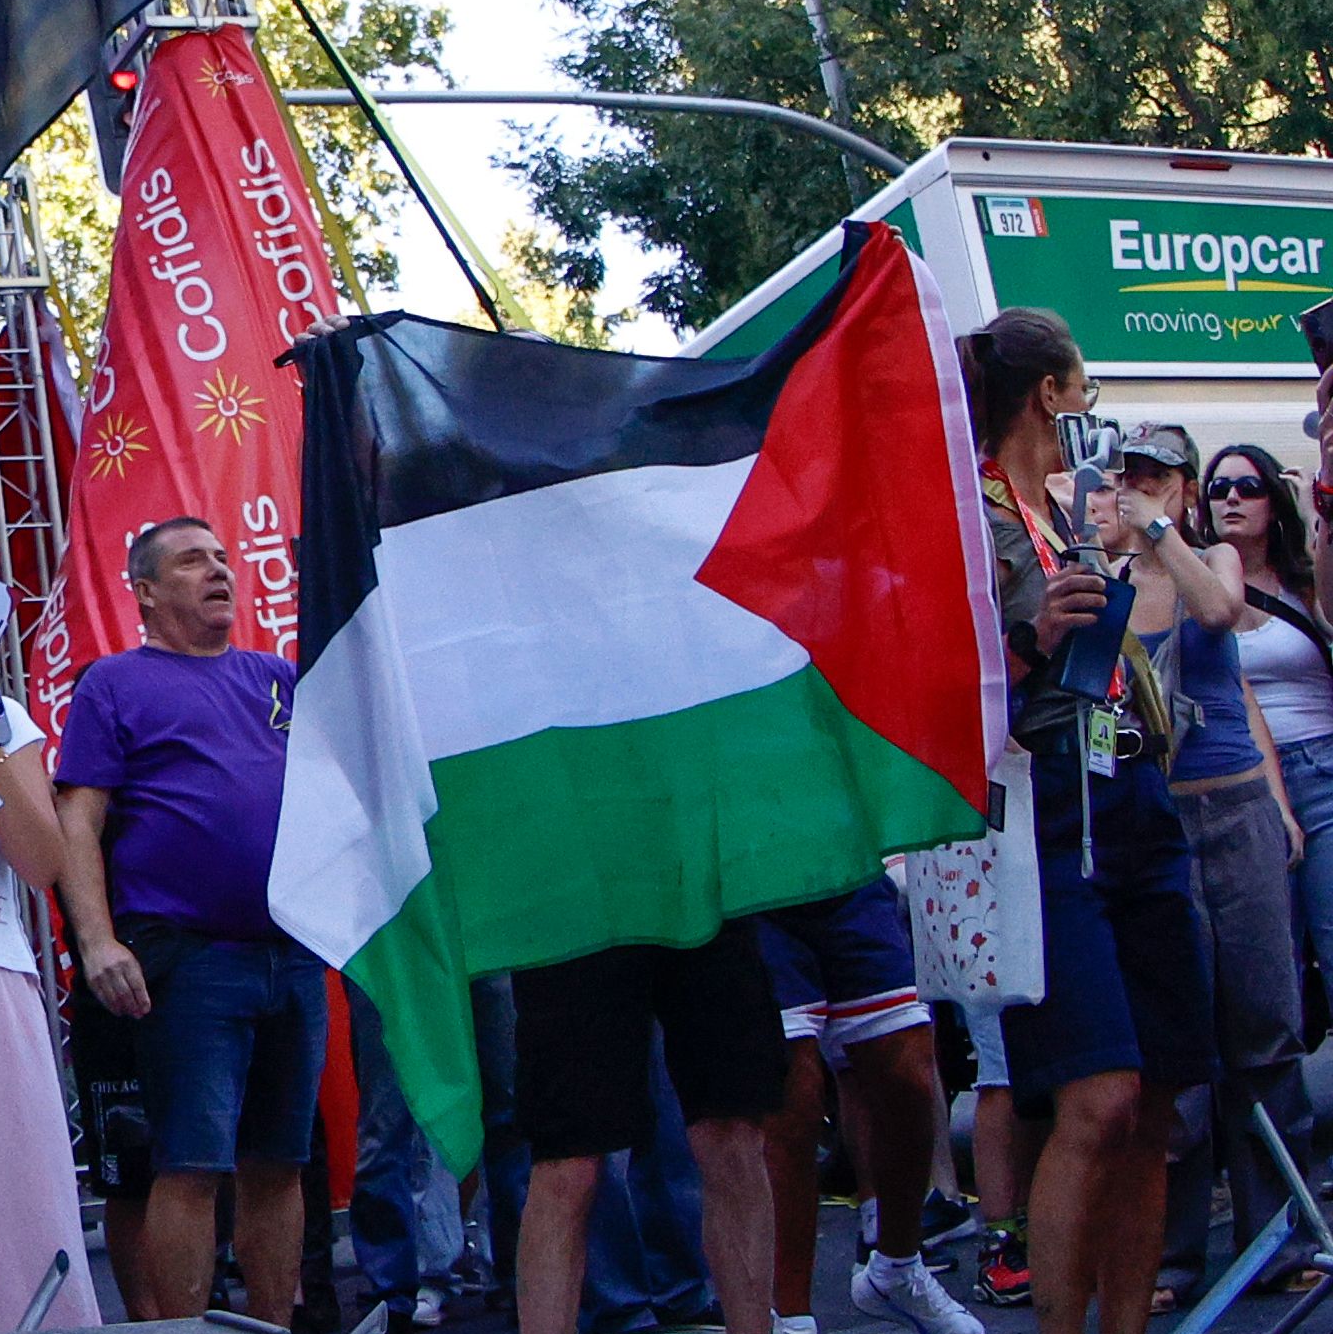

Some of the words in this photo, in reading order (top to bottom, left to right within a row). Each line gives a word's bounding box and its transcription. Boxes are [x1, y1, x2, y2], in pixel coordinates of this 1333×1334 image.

[240, 138, 324, 347] Cofidis
[1000, 213, 1025, 233] 972
[1109, 219, 1324, 291] Europcar
[136, 167, 227, 362] Cofidis
[1125, 308, 1222, 341] moving
[1224, 313, 1282, 341] your
[37, 576, 75, 775] ofidis
[90, 1079, 140, 1094] CHICAG
